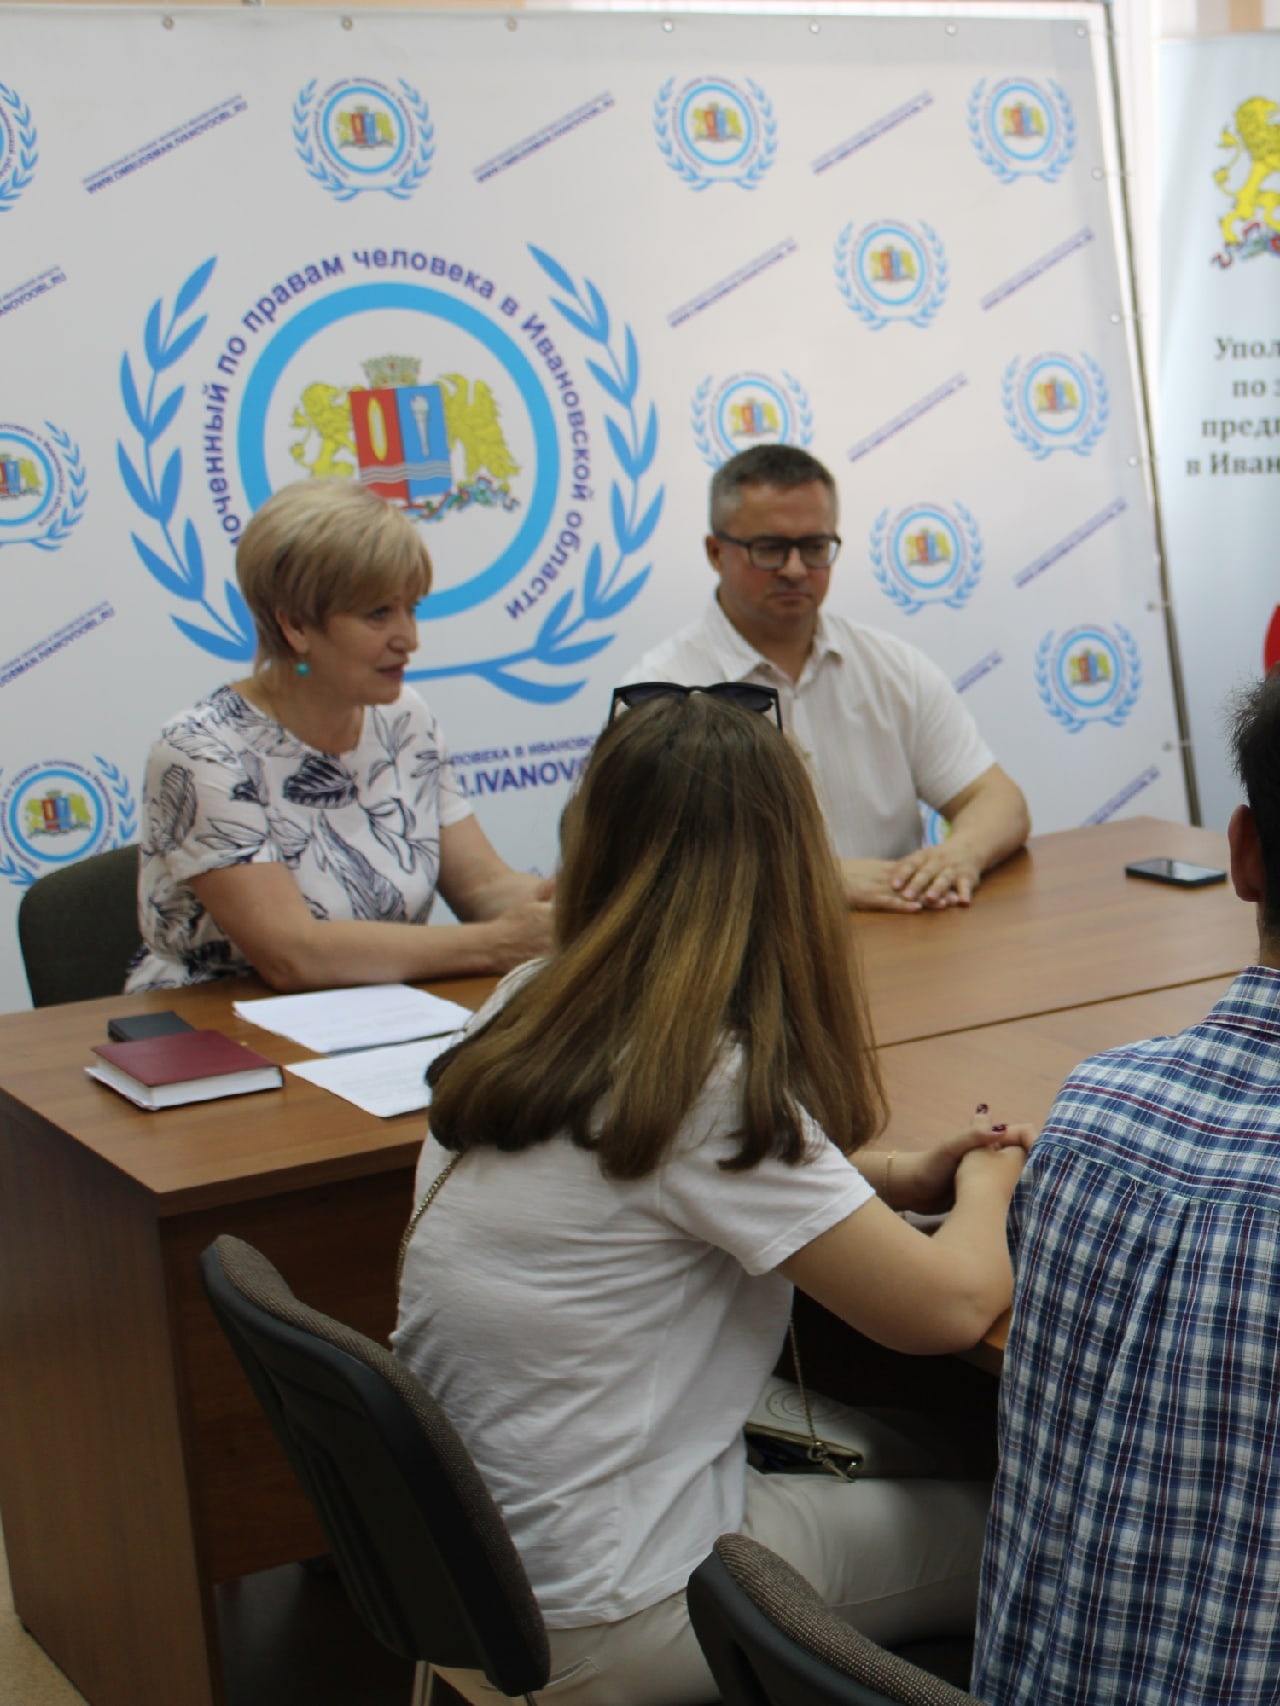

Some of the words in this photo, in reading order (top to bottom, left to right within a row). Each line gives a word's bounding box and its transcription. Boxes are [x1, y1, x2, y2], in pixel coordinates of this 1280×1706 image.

[242, 255, 345, 333] правам
[352, 248, 495, 300] человека
[500, 296, 519, 317] в
[217, 336, 247, 376] по
[520, 312, 595, 502] Ивановской
[1232, 379, 1267, 398] по
[202, 382, 242, 546] оченный
[1185, 458, 1201, 476] в
[504, 510, 582, 621] области
